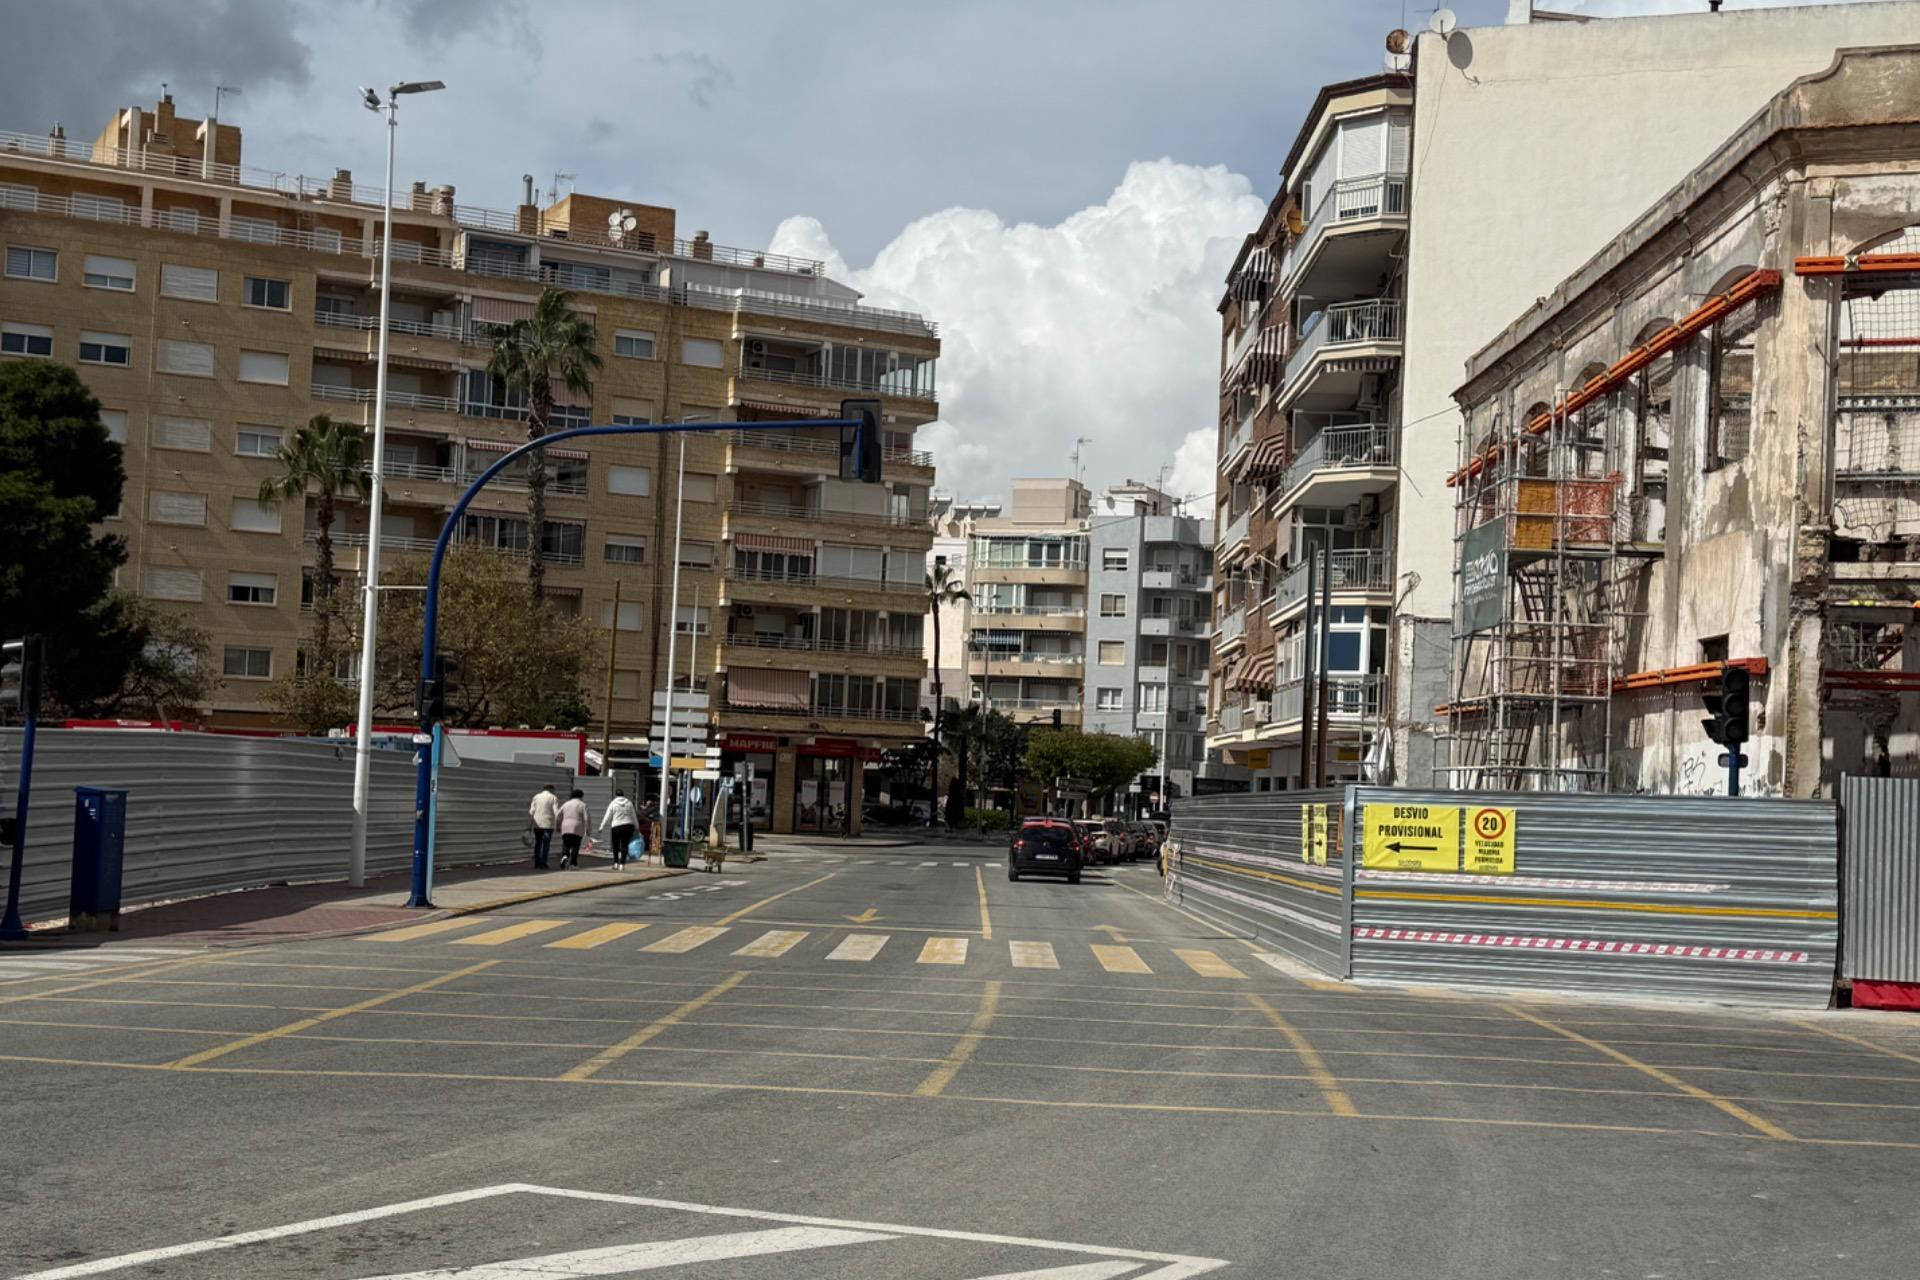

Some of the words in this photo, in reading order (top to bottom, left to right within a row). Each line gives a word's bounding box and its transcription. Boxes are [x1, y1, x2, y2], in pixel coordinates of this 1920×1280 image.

[729, 738, 777, 750] MAPFRE
[1393, 807, 1429, 820] DESVIO
[1482, 817, 1498, 831] 20
[1378, 825, 1443, 838] PROVISIONAL
